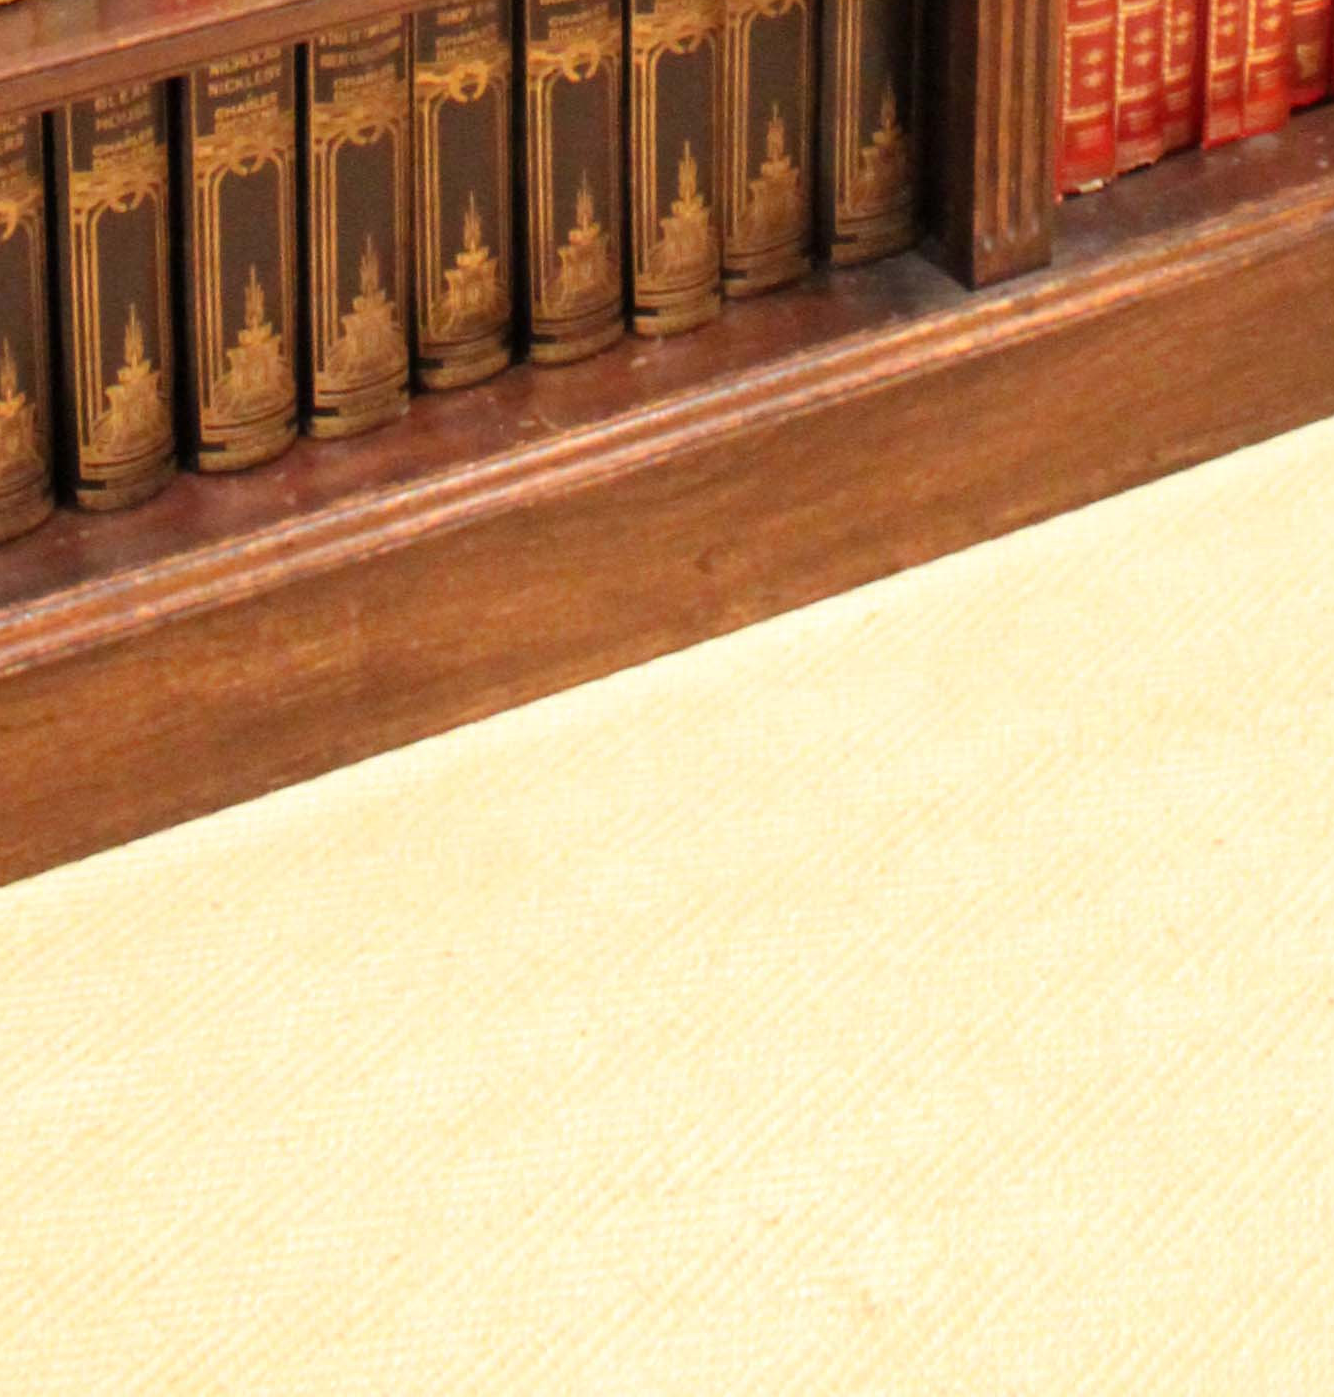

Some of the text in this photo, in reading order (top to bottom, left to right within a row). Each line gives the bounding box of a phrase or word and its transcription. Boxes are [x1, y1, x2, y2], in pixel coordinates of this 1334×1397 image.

[207, 63, 282, 98] NICKLEBY
[93, 83, 150, 113] BLEAK
[95, 101, 153, 131] HOUSE
